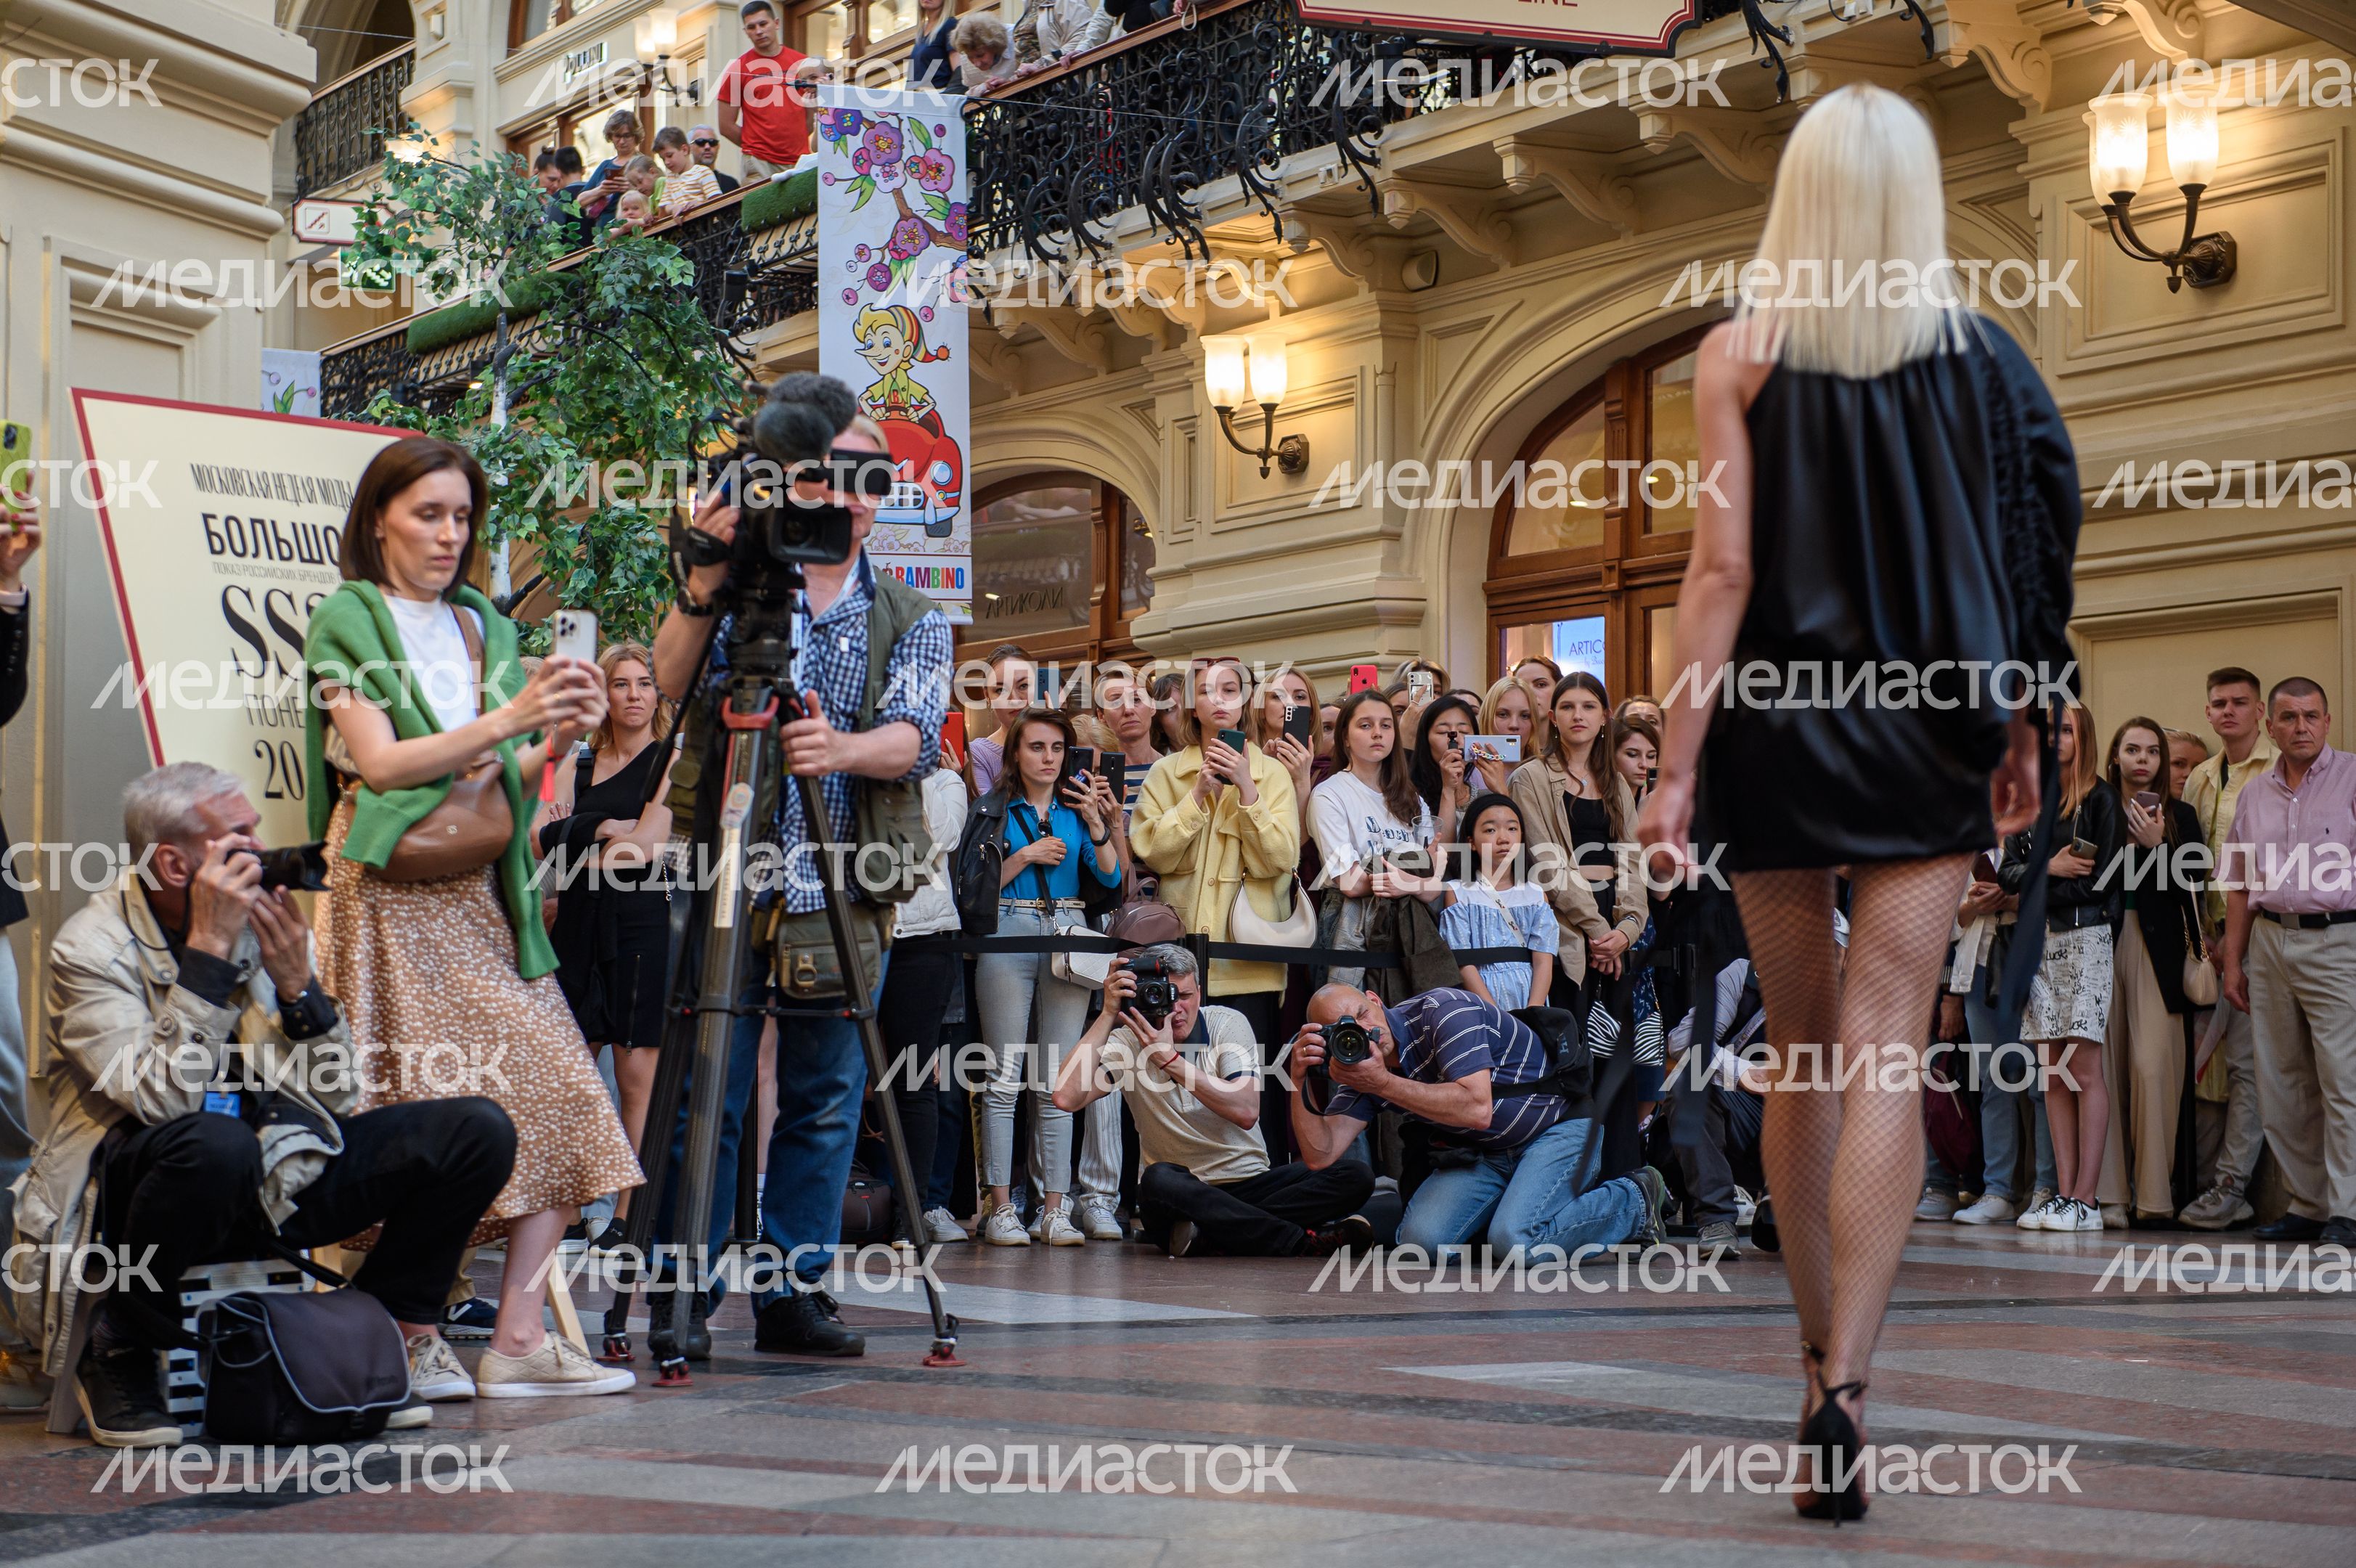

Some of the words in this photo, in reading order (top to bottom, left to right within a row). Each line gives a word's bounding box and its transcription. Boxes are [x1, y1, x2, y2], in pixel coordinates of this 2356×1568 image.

[190, 462, 274, 500] МОСКОВСКАЯ
[271, 472, 318, 507] НЕДЕЛЯ
[895, 566, 964, 589] BAMBINO
[985, 587, 1064, 619] АРТИКОЛИ
[221, 584, 327, 682] SS
[1569, 639, 1605, 656] ARTIC
